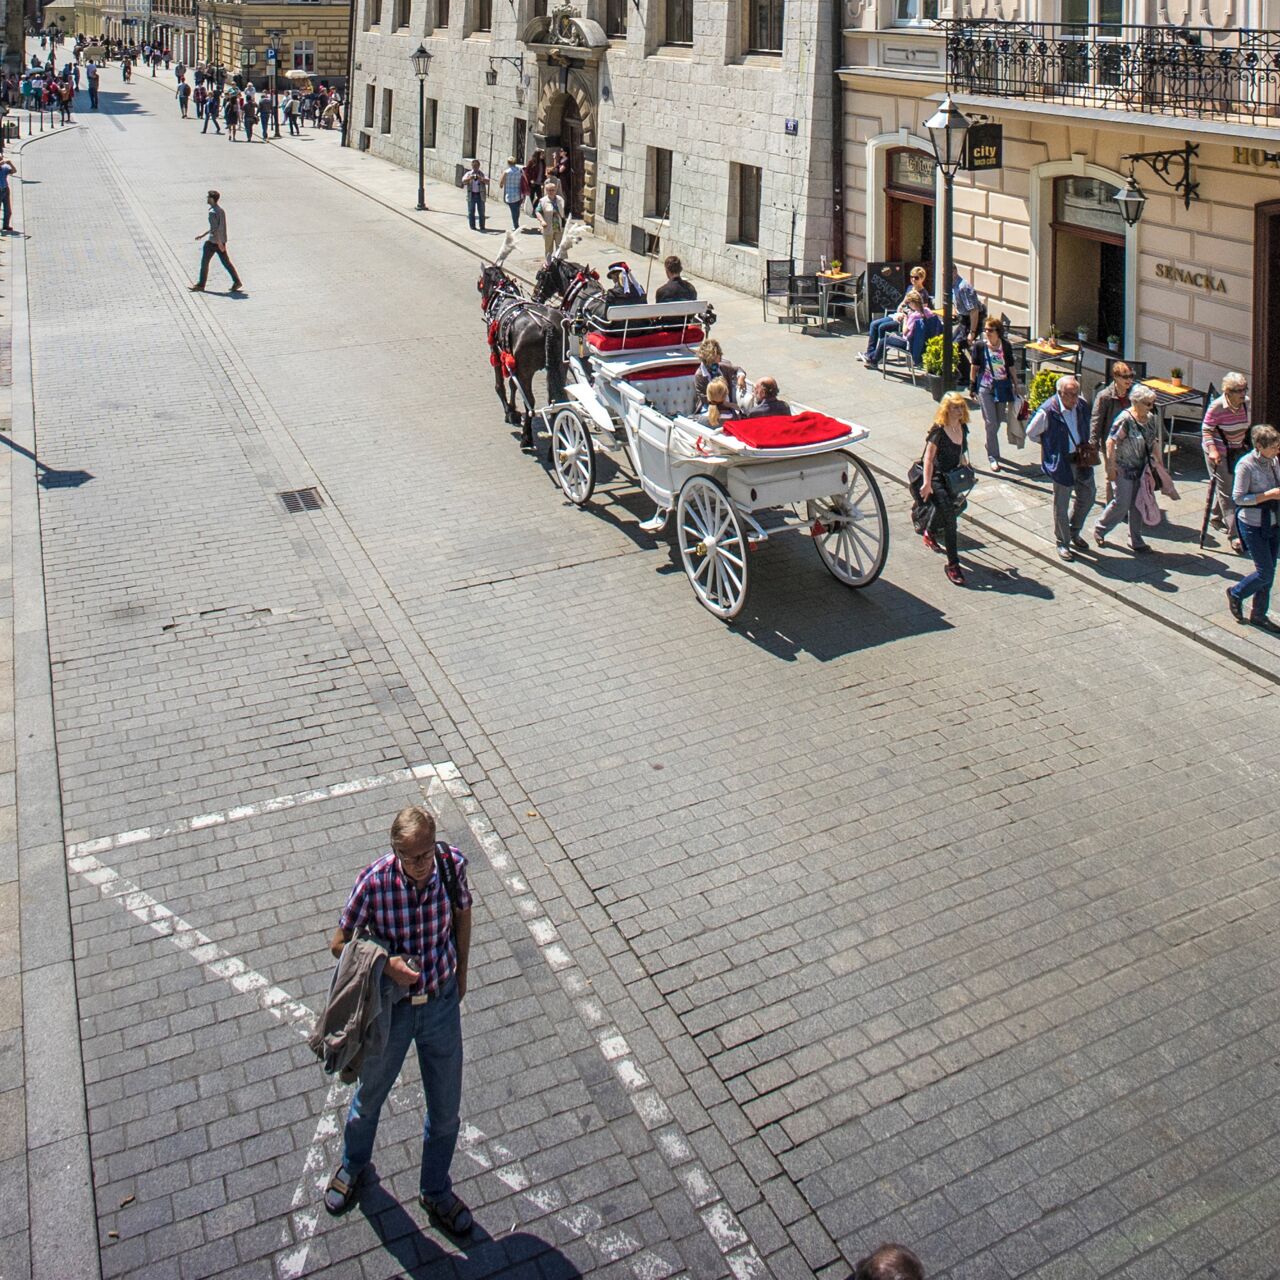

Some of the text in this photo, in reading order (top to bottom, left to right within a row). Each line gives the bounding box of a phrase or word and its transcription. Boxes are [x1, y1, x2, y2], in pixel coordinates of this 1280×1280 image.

[268, 49, 276, 58] P
[973, 145, 996, 158] city
[1155, 263, 1227, 293] SENACKA
